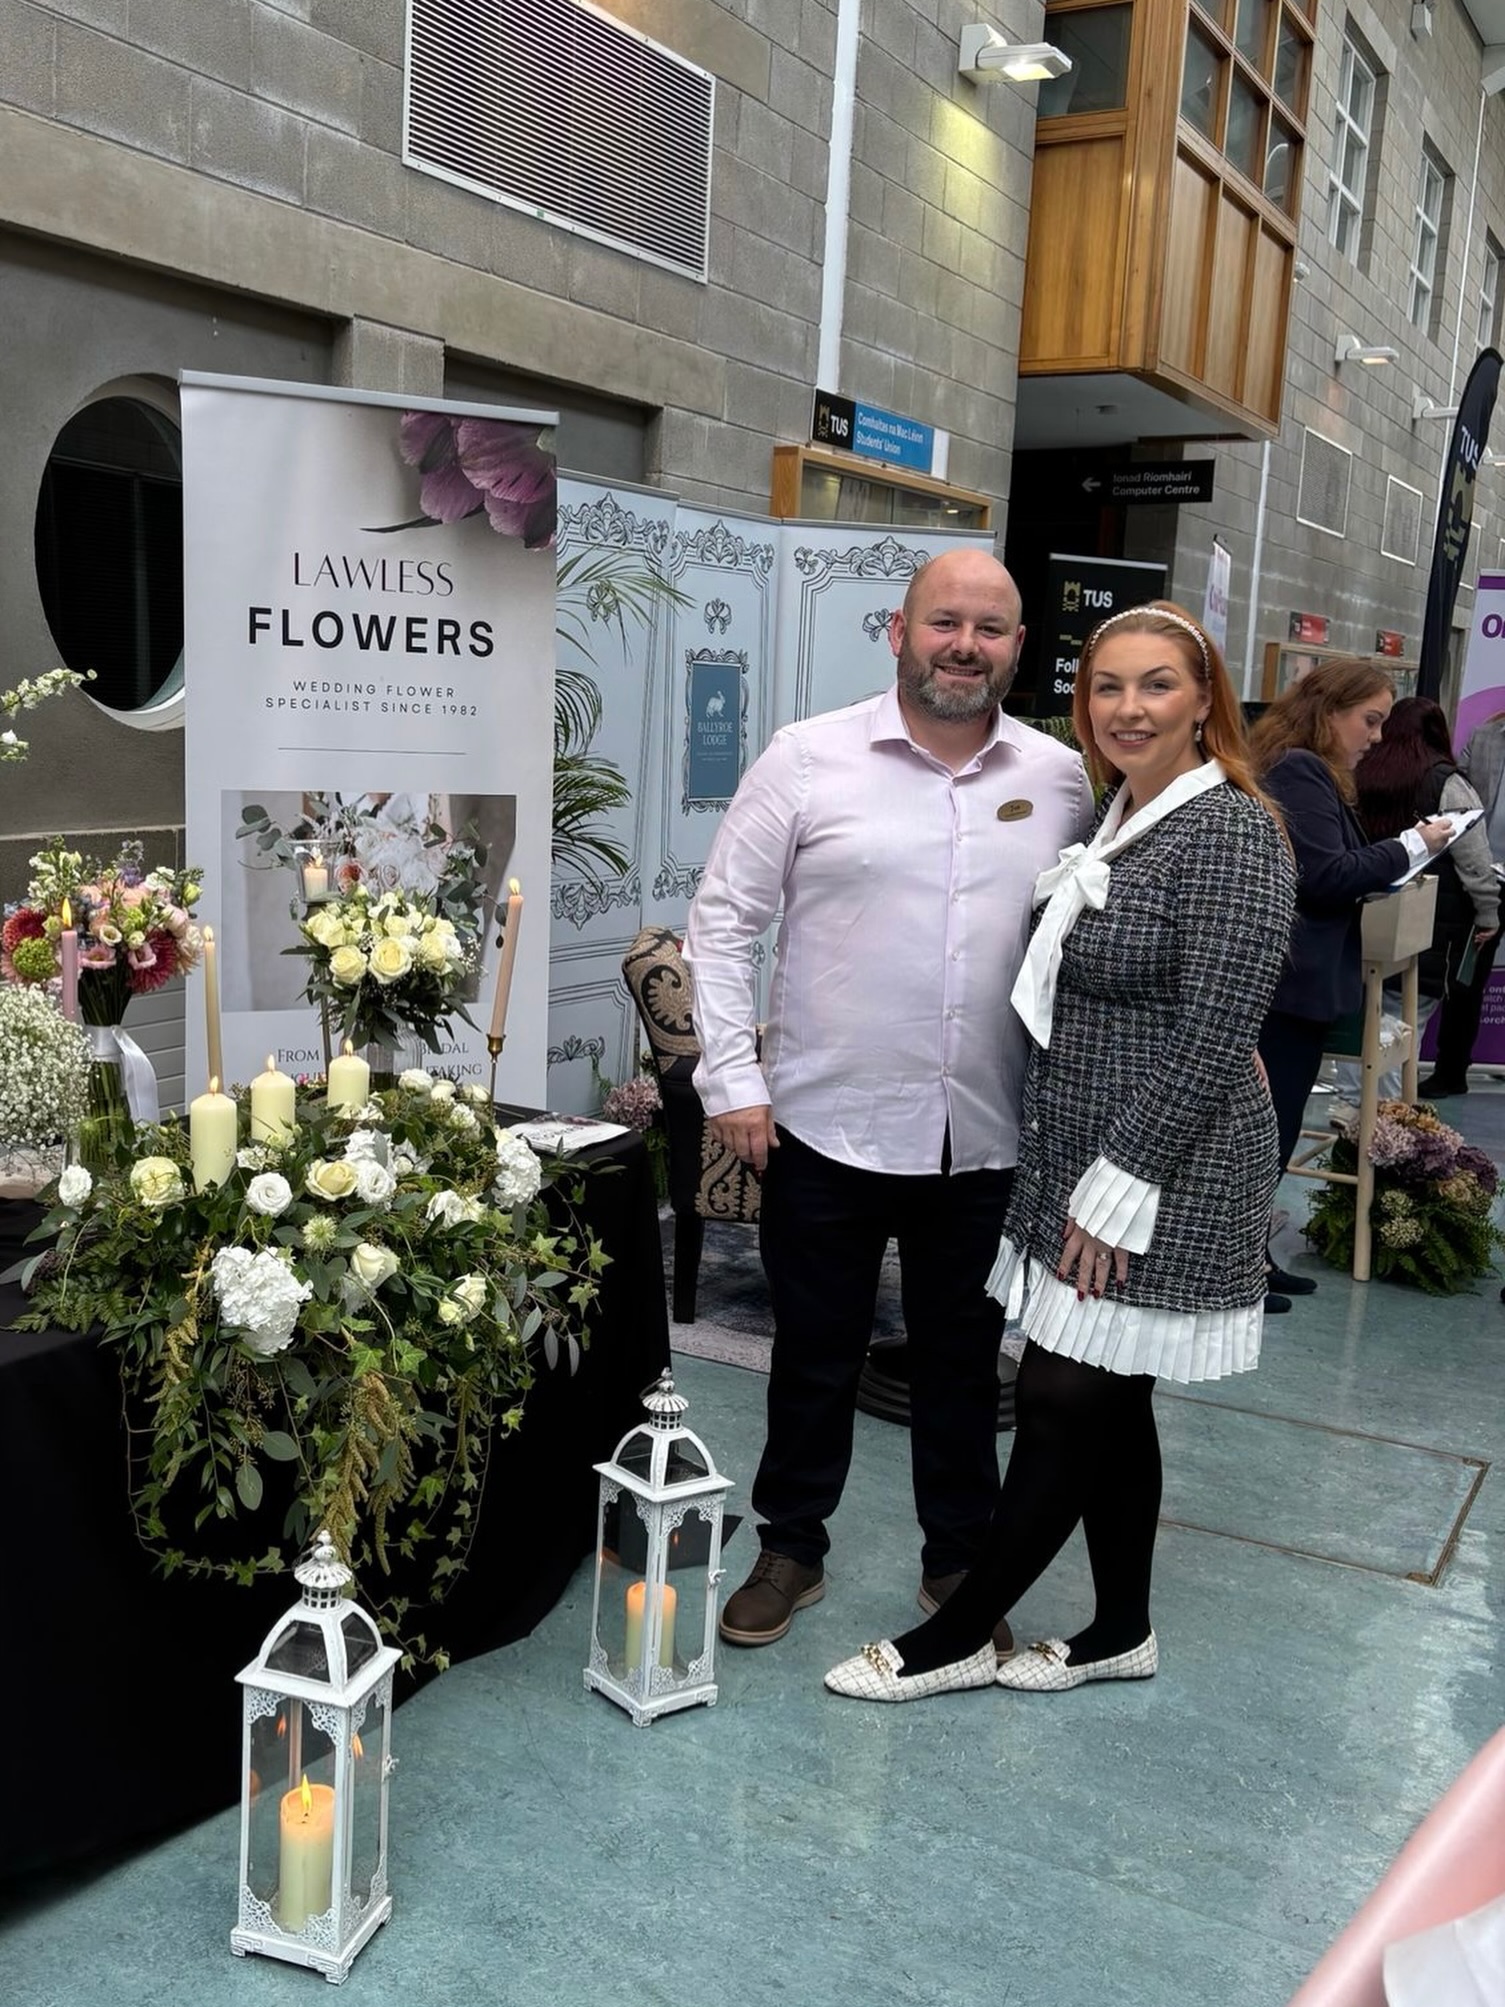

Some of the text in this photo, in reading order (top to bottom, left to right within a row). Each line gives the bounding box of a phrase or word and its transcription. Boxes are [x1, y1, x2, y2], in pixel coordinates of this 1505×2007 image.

[830, 415, 849, 437] TUS
[884, 439, 901, 455] Union
[1113, 472, 1141, 483] Ionad
[1112, 485, 1200, 497] Computer Centre
[294, 552, 454, 597] LAWLESS
[1083, 589, 1113, 608] TUS
[248, 606, 494, 658] FLOWERS
[1481, 613, 1505, 639] O
[1055, 657, 1080, 674] Foll
[293, 681, 454, 698] WEDDING FLOWER
[1053, 679, 1076, 695] Soc
[265, 697, 478, 716] SPECIALIST SINCE 1982
[703, 734, 728, 746] LODGE
[277, 1042, 469, 1063] FROM BDAL
